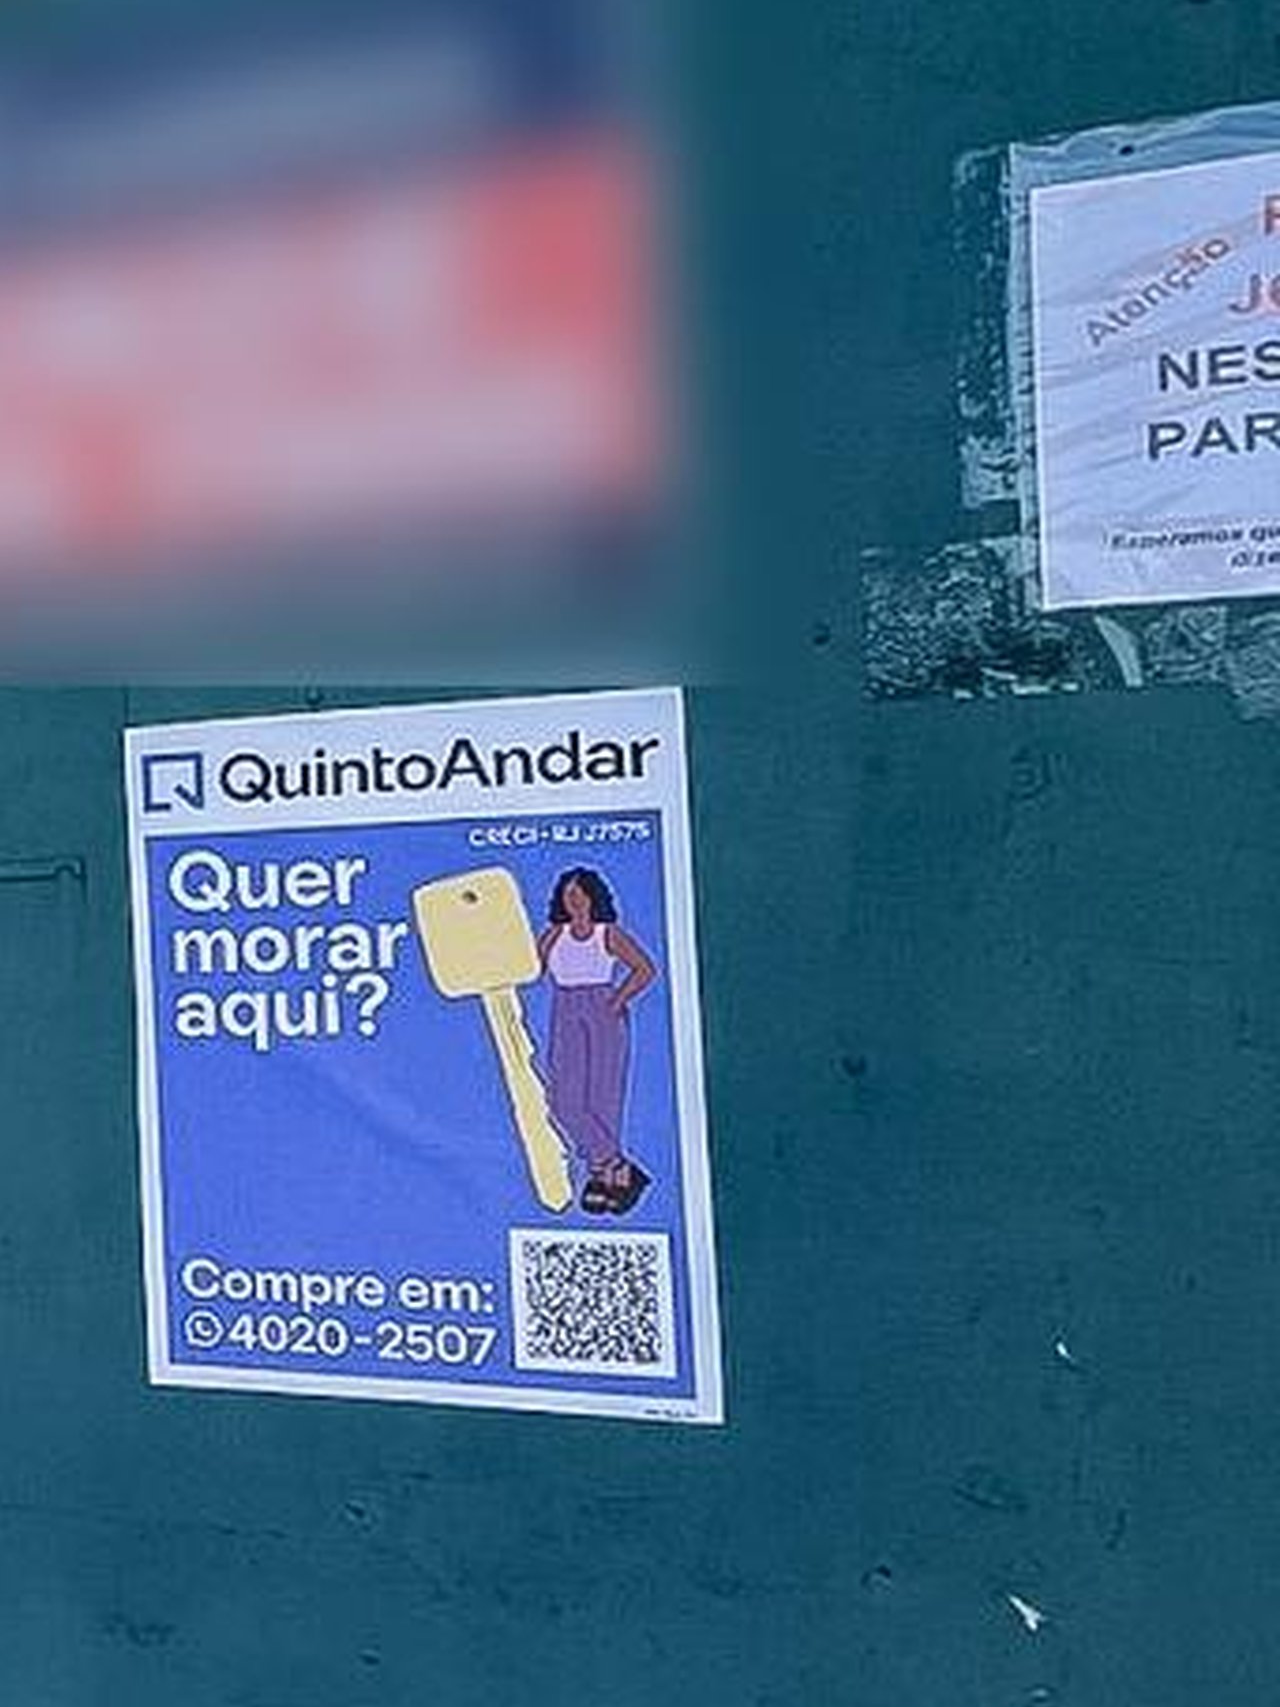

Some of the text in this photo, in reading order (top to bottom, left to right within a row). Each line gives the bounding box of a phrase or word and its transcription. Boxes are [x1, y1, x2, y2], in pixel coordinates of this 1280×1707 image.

[219, 731, 659, 803] QuintoAndar
[169, 850, 366, 912] Quer
[173, 922, 409, 973] morar
[176, 972, 389, 1051] aqui?
[182, 1258, 494, 1312] Compre em:
[228, 1314, 497, 1366] 4020-2507
